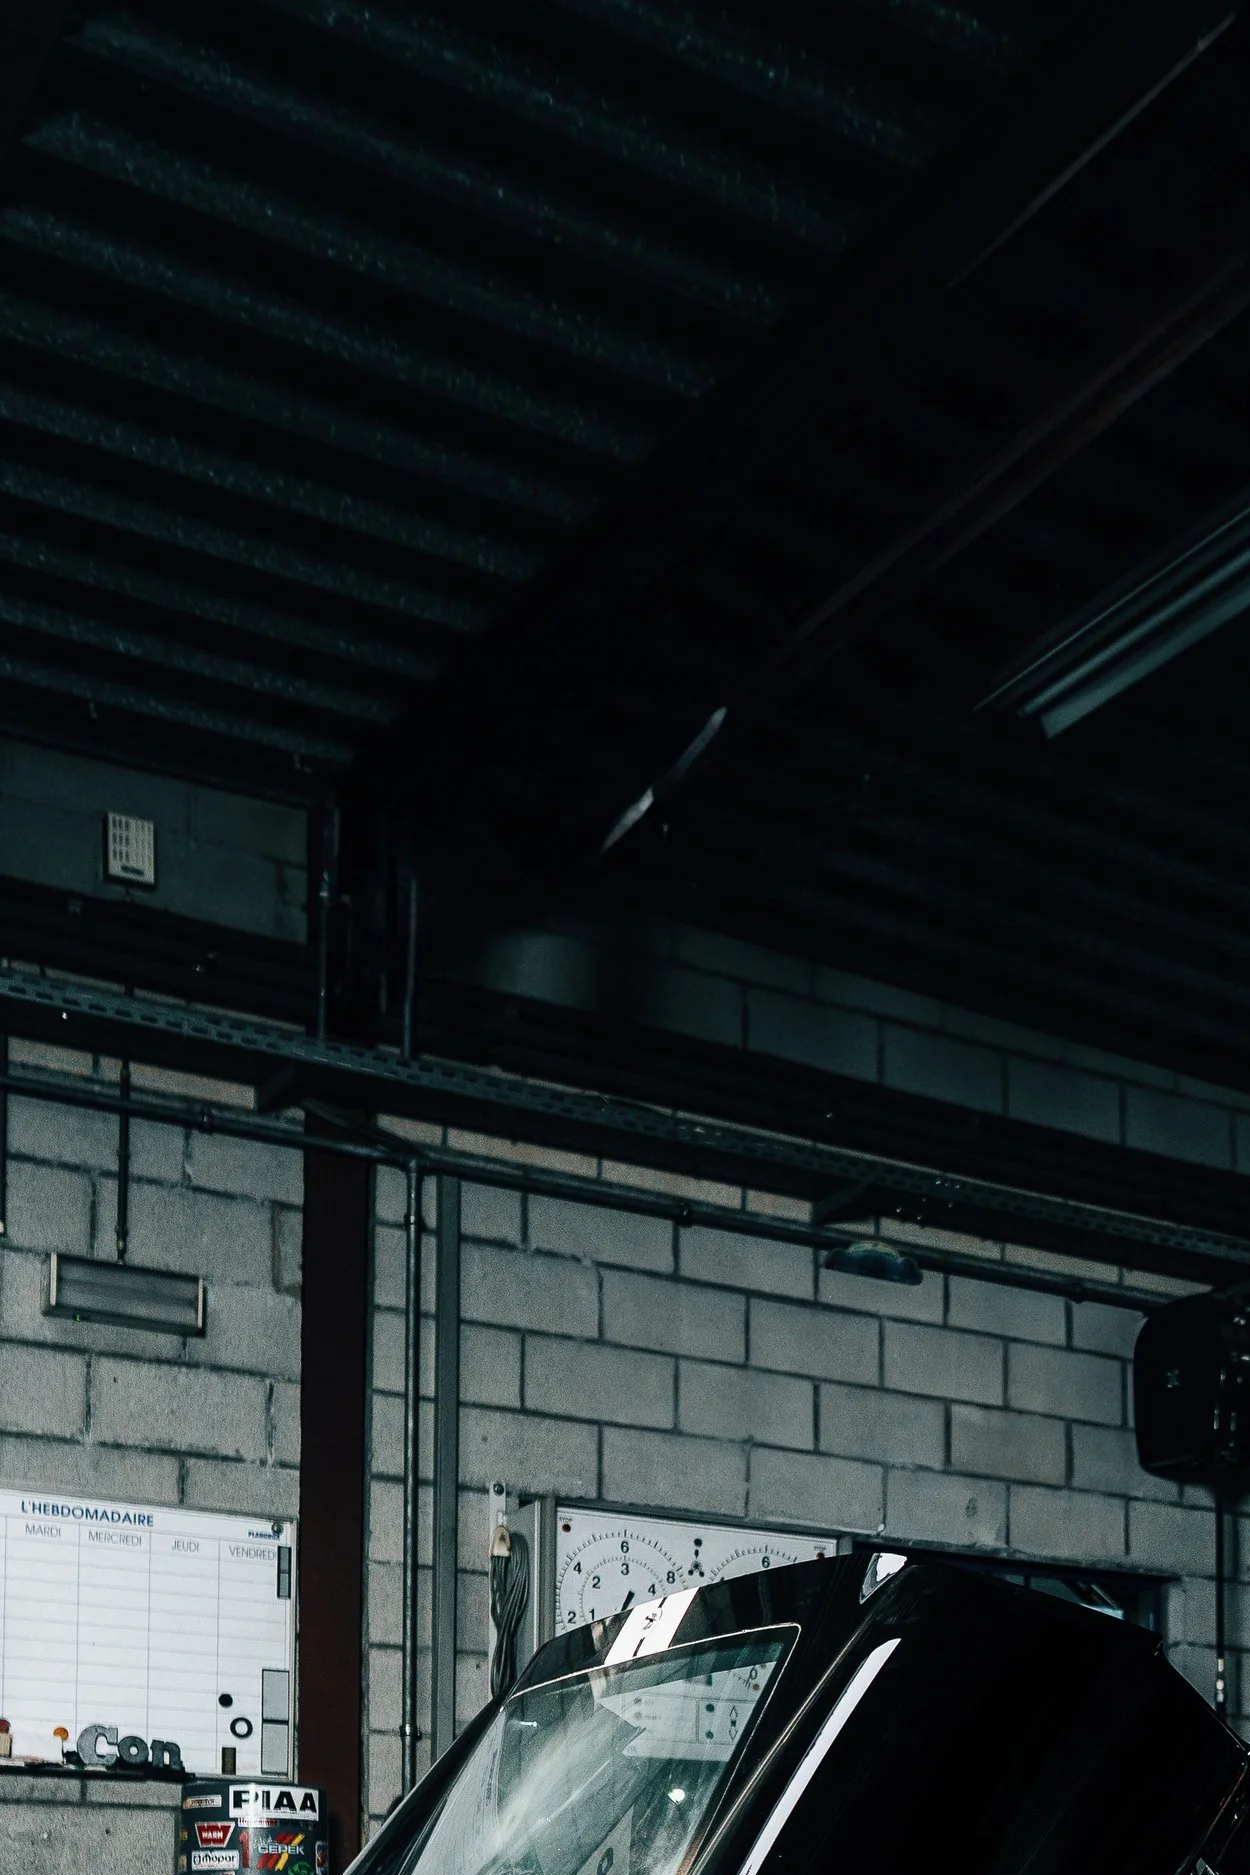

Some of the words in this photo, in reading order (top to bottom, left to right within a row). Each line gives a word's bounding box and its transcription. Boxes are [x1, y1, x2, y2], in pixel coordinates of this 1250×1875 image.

[21, 1500, 154, 1527] L'HEBDOMADAIRE
[25, 1523, 61, 1538] MARDI
[88, 1529, 142, 1546] MERCREDI
[171, 1539, 200, 1553] JEUDI
[620, 1541, 629, 1554] 6
[573, 1562, 582, 1575] 4
[762, 1556, 770, 1569] 6
[620, 1563, 629, 1576] 3
[592, 1576, 601, 1589] 2
[666, 1571, 676, 1584] 8
[647, 1583, 656, 1597] 4
[568, 1611, 577, 1624] 2
[589, 1609, 595, 1622] 1
[232, 1790, 317, 1813] PIAA
